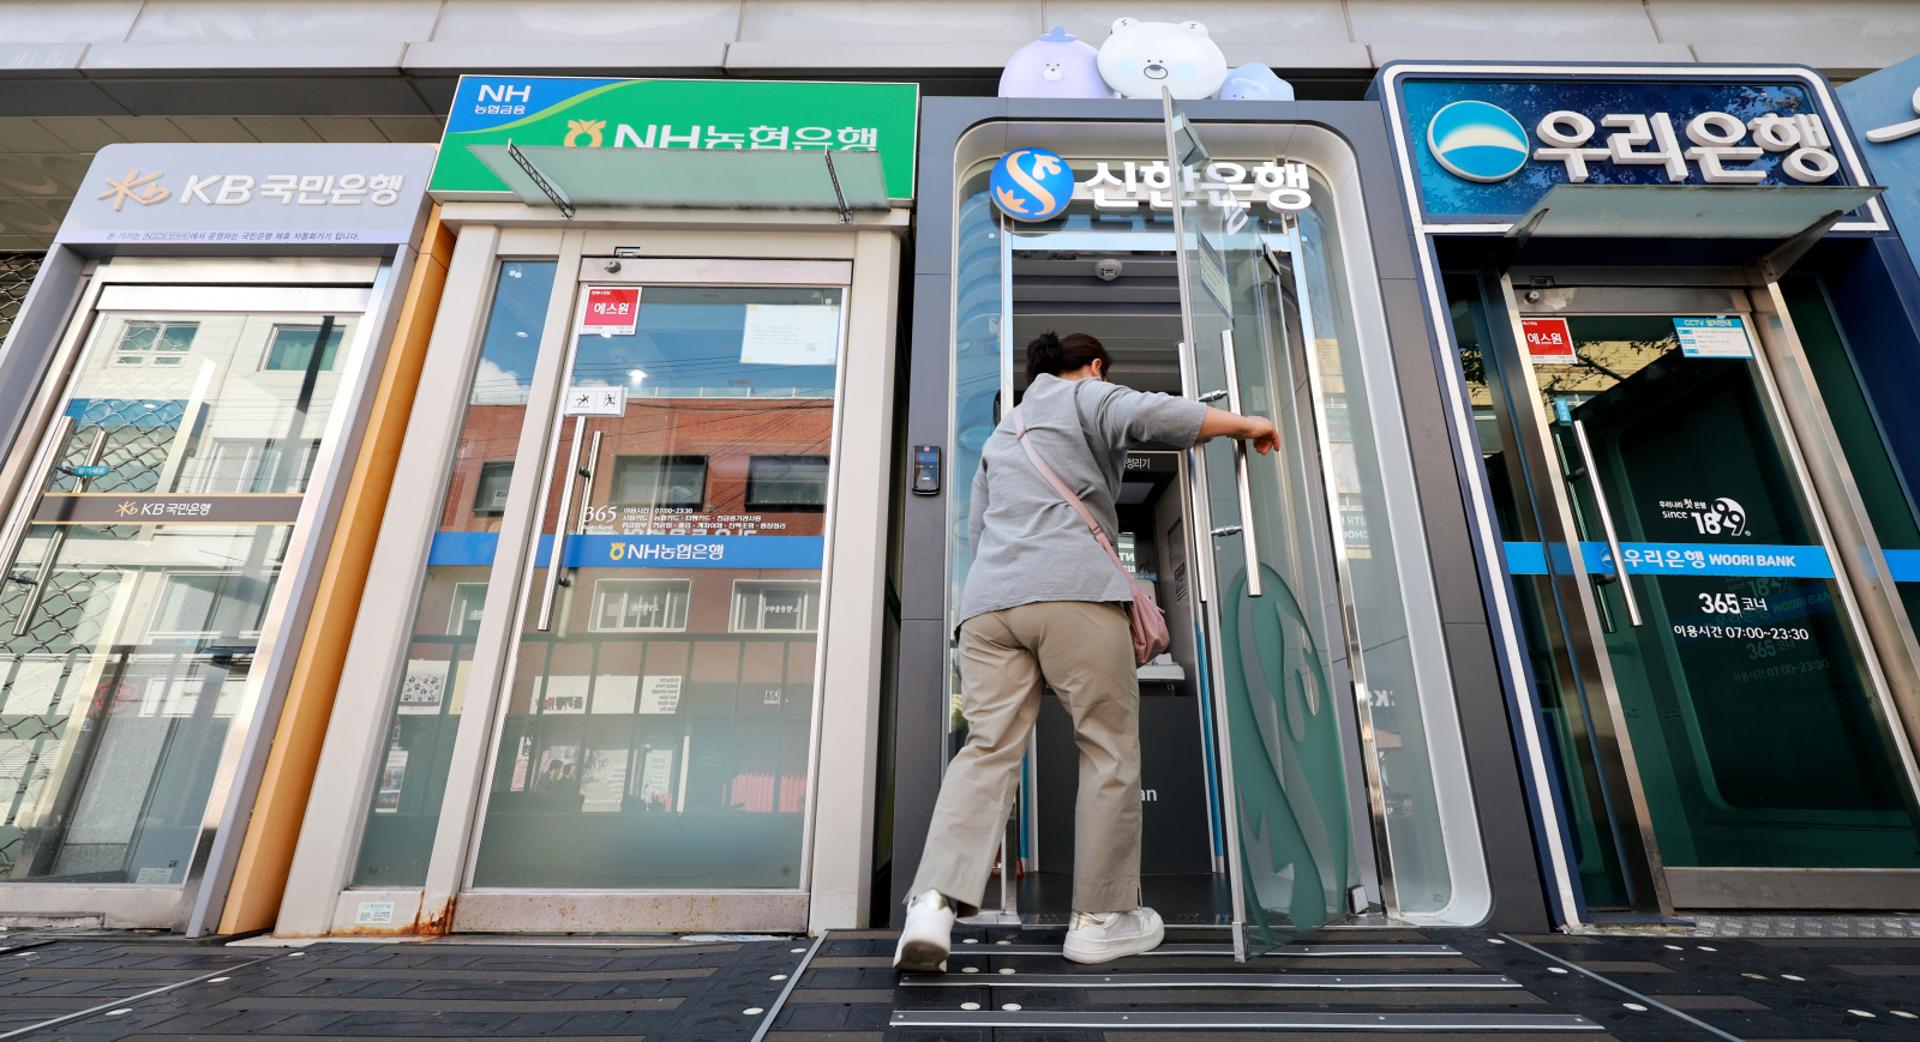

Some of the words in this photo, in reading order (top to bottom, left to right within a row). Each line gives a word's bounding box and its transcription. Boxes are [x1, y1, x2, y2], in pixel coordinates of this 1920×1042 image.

[478, 84, 532, 103] NH
[474, 104, 527, 115] 농협금융
[1532, 110, 1840, 184] 우리은행
[179, 174, 256, 206] KB
[260, 173, 405, 207] 국민은행
[1084, 160, 1313, 214] 신한은행
[593, 302, 630, 316] 에스원
[1527, 332, 1563, 345] 에스원
[140, 503, 166, 516] KB
[166, 502, 212, 516] 국민은행
[584, 504, 618, 524] 365
[1693, 501, 1707, 510] 은행
[626, 543, 725, 561] NH농협은행
[1622, 548, 1707, 569] 우리은행
[1708, 553, 1755, 567] WOORI
[1756, 555, 1797, 568] BANK
[1697, 592, 1742, 615] 365
[1741, 596, 1769, 612] 코너
[1673, 624, 1723, 639] 이용시간
[1725, 626, 1810, 641] 07:00~23:30
